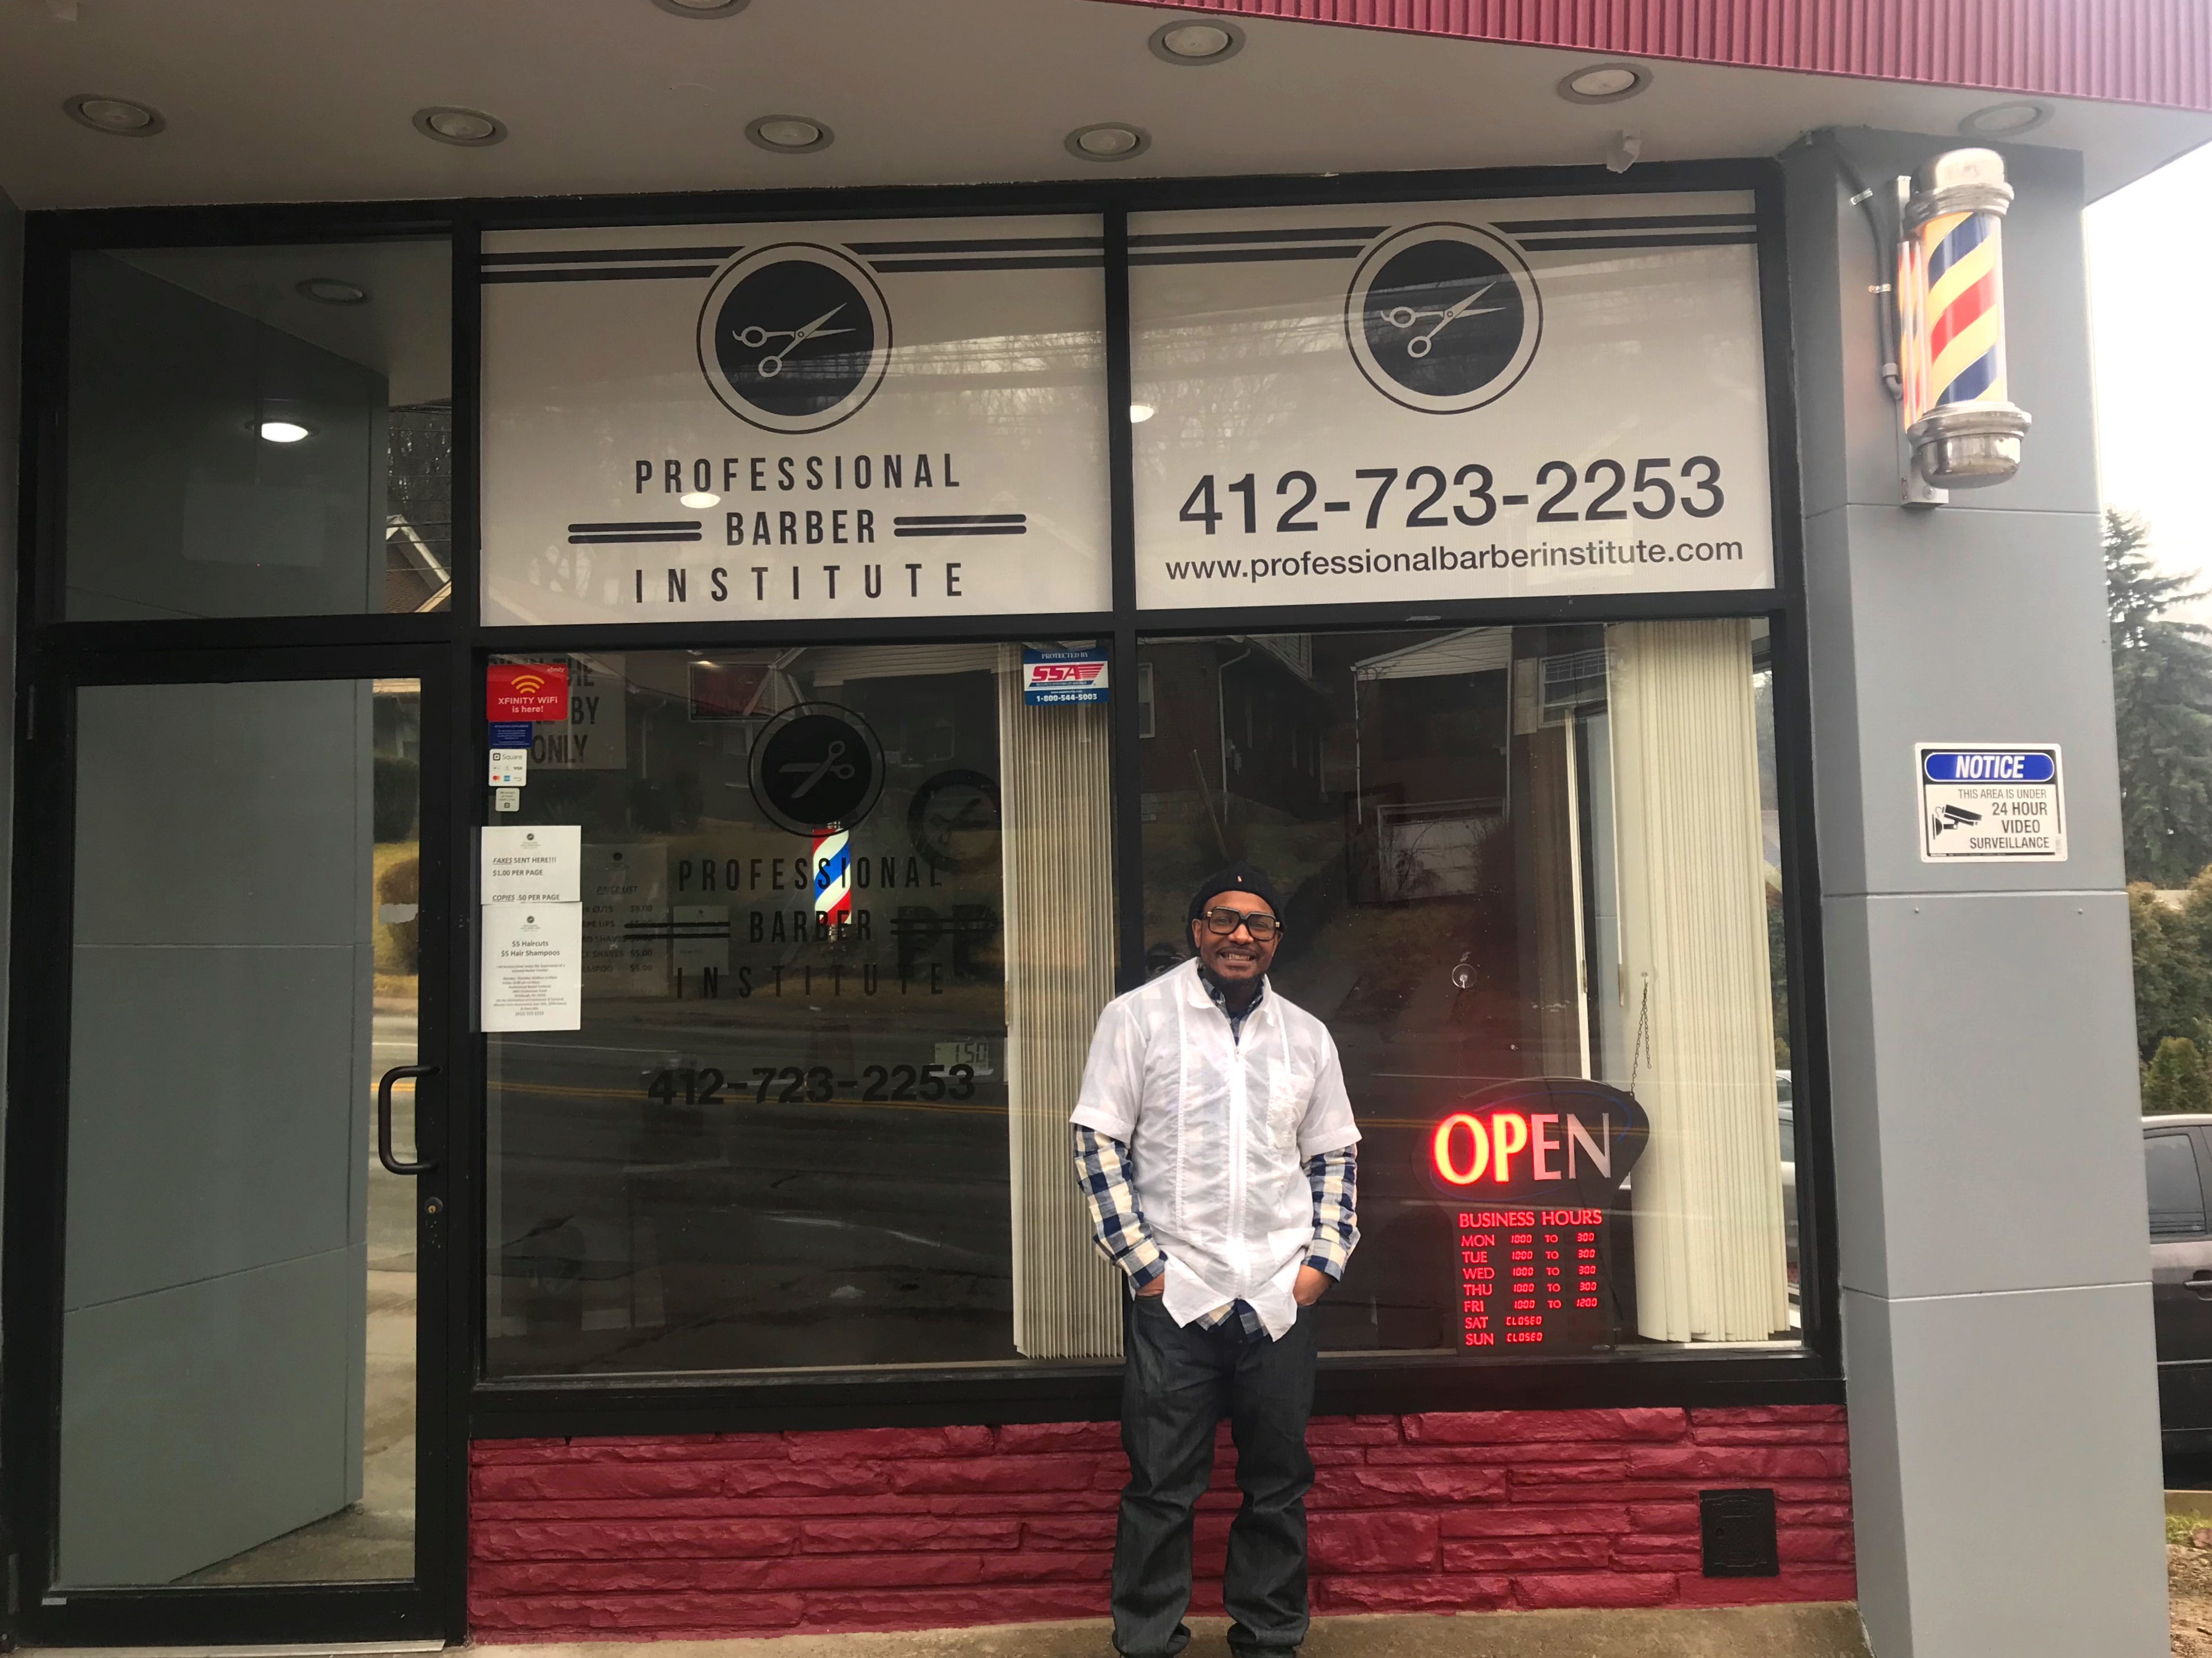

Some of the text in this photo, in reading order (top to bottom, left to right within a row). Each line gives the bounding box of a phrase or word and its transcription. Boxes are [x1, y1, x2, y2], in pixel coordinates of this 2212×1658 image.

[636, 454, 960, 494] PROFESSIONAL
[1179, 455, 1725, 535] 412-723-2253
[727, 510, 875, 546] BARBER
[1166, 537, 1743, 583] www.professionalbarberinstitute.com
[636, 563, 963, 603] INSTITUTE
[1032, 665, 1082, 682] SSA
[1037, 694, 1097, 702] 1-800-544-5003
[571, 696, 600, 724] BY
[531, 734, 588, 764] ONLY
[1956, 755, 2025, 778] NOTICE
[1958, 789, 2047, 799] THIS AREA IS UNDER
[1991, 802, 2047, 816] 24 HOUR
[2002, 820, 2040, 833] VIDEO
[1970, 837, 2050, 849] SURVEILLANCE
[678, 856, 942, 891] PROFESSIONAL
[750, 910, 871, 943] BARBER
[677, 963, 943, 999] INSTITUTE
[647, 1064, 975, 1105] 412-723-2253
[1432, 1112, 1611, 1185] OPEN
[1459, 1209, 1602, 1228] BUSINESS HOURS
[1461, 1235, 1495, 1247] MON
[1544, 1235, 1558, 1243] TO
[1462, 1251, 1488, 1264] TUE
[1545, 1250, 1559, 1260] TO
[1463, 1267, 1495, 1280] WED
[1546, 1267, 1560, 1276] TO
[1463, 1284, 1493, 1296] THU
[1547, 1284, 1561, 1292] TO
[1464, 1300, 1484, 1313] FRI
[1547, 1300, 1562, 1309] TO
[1465, 1316, 1542, 1329] SAT CLOSED
[1465, 1332, 1543, 1346] SUN CLOSED
